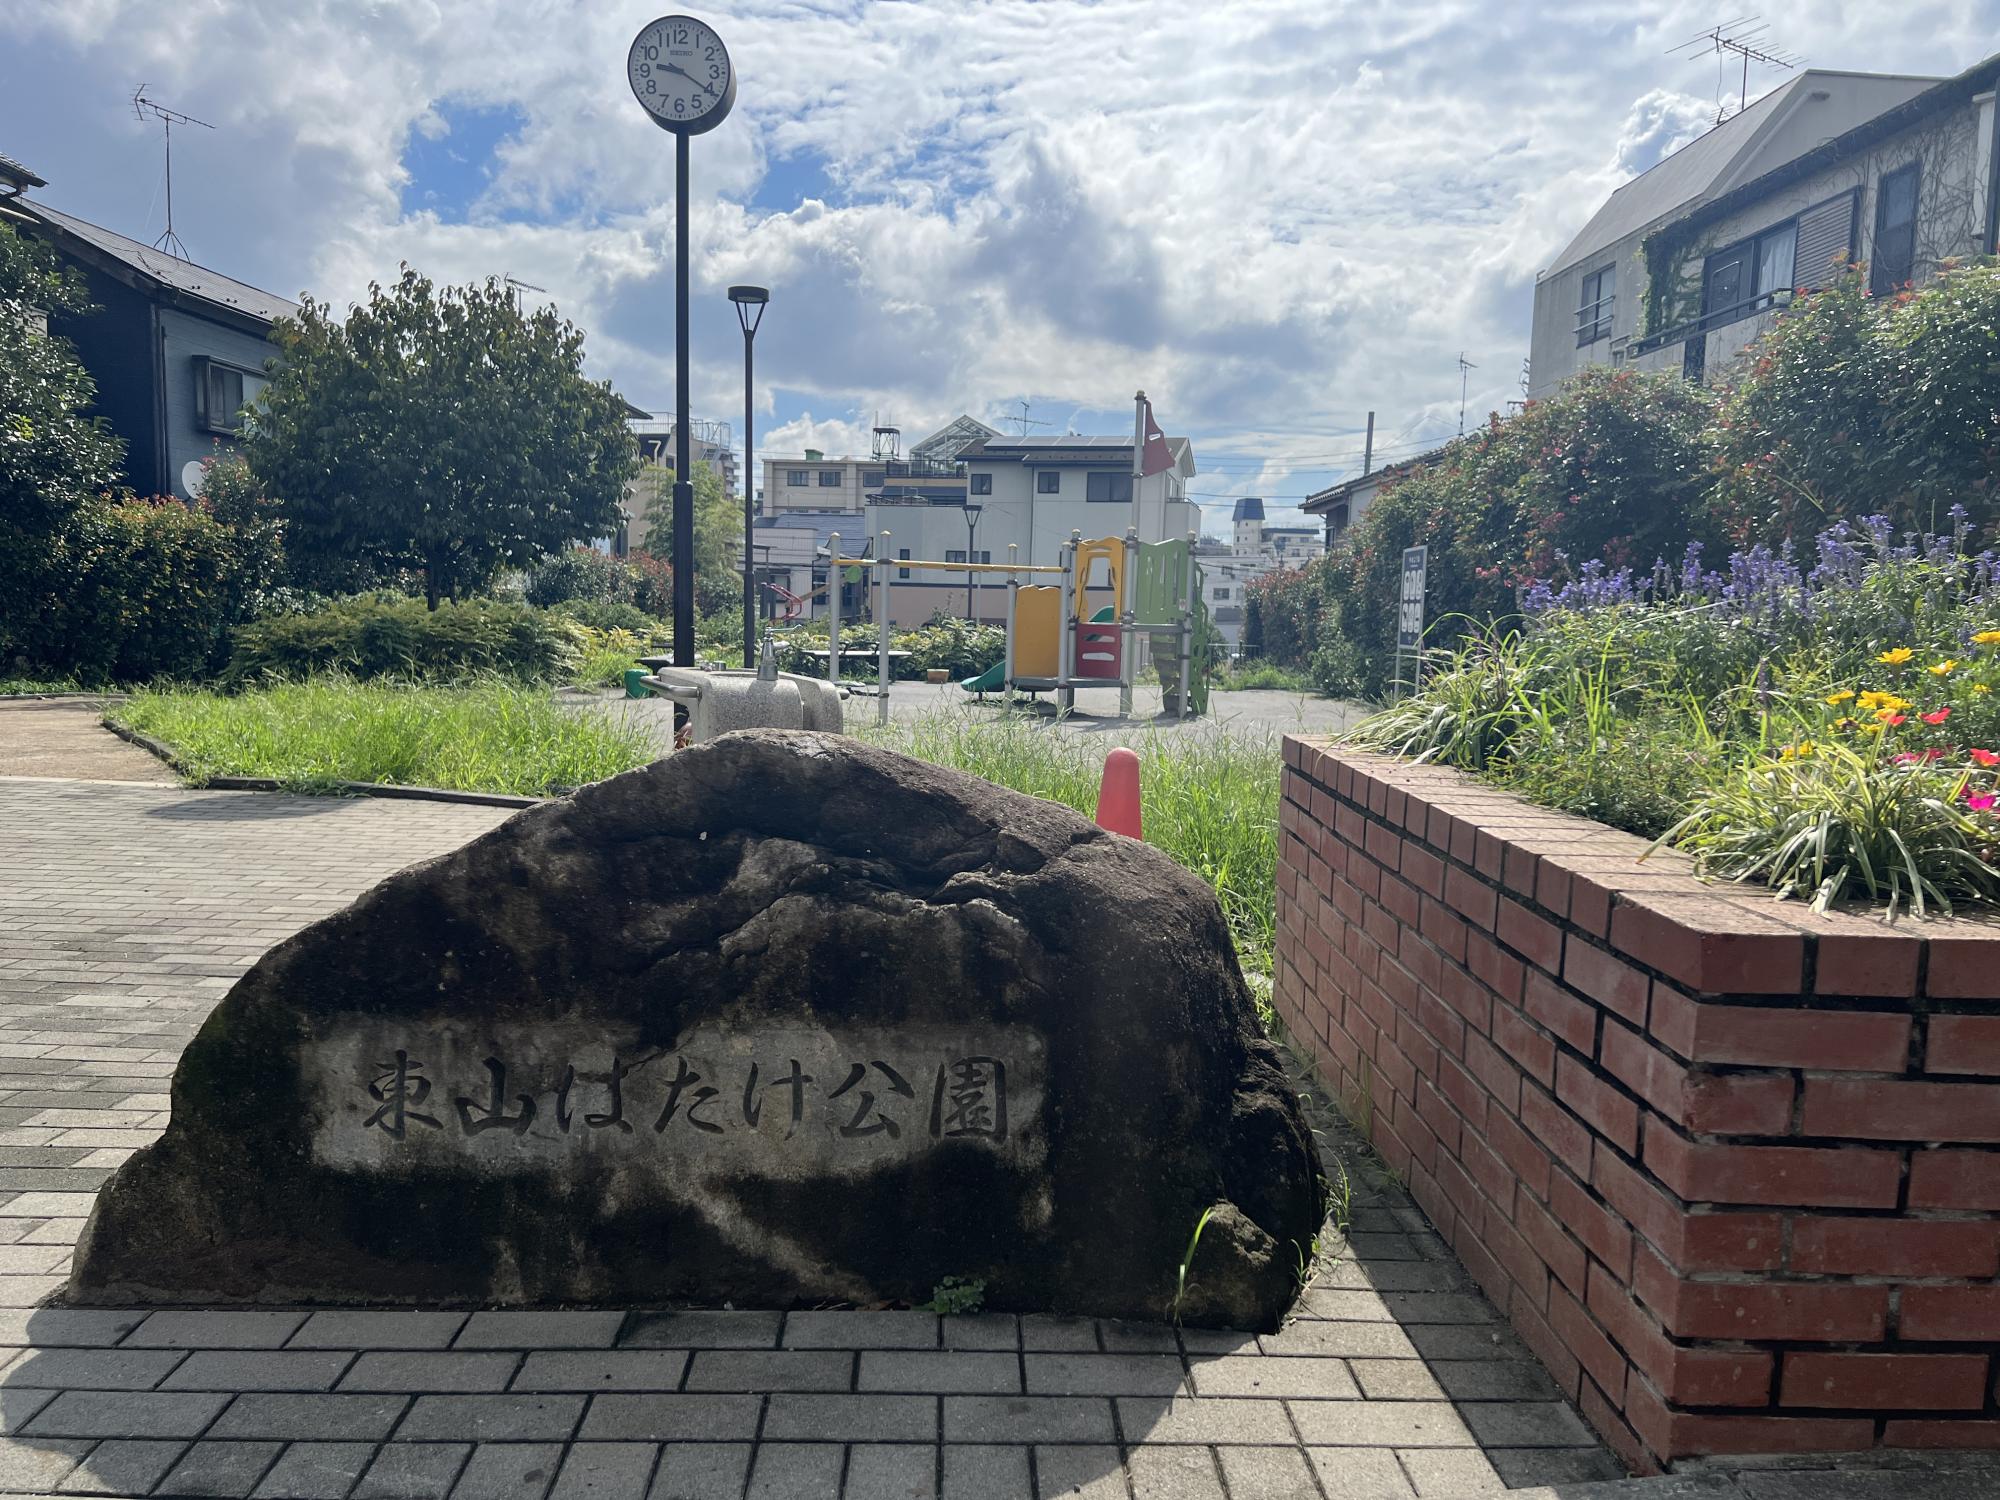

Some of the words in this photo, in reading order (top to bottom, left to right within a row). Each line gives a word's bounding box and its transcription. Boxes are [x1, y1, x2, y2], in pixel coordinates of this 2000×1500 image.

[659, 33, 670, 47] 11
[673, 29, 689, 44] 12
[696, 34, 700, 48] 1
[644, 46, 658, 60] 10
[704, 46, 715, 61] 2
[640, 63, 651, 78] 9
[709, 65, 720, 79] 3
[646, 80, 656, 94] 8
[704, 82, 715, 93] 4
[659, 94, 670, 108] 7
[674, 98, 685, 113] 6
[691, 94, 702, 109] 5
[363, 1050, 1008, 1143] 東山はたけ公園
